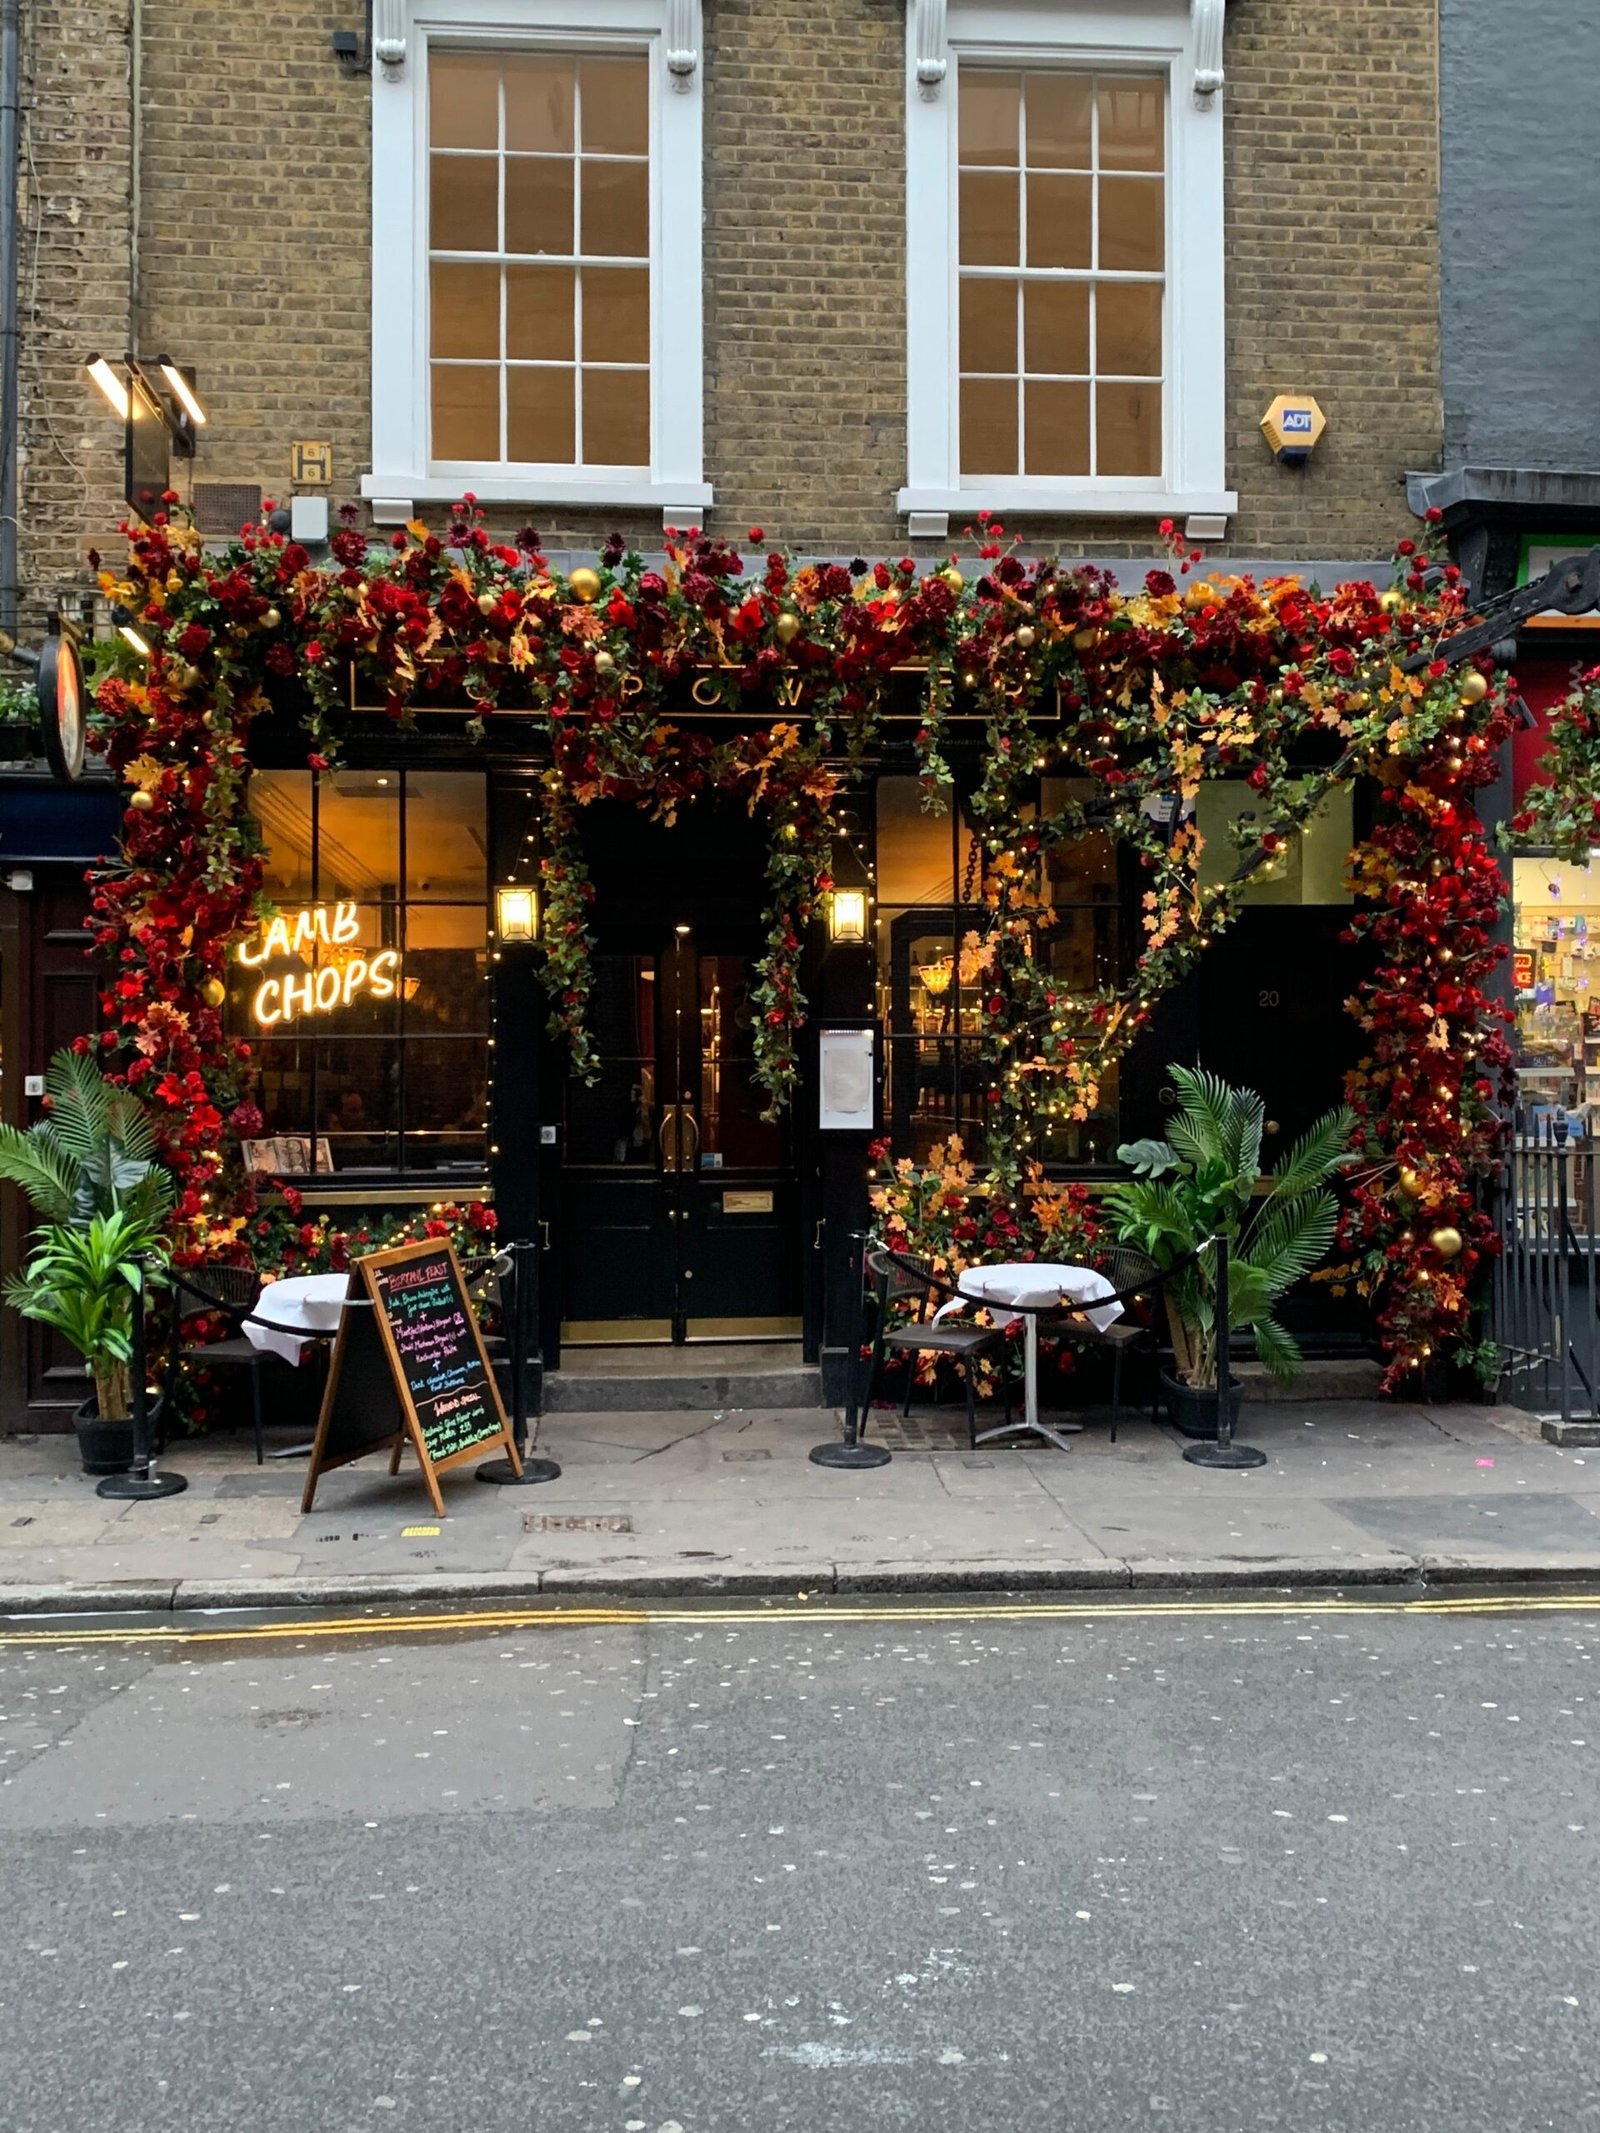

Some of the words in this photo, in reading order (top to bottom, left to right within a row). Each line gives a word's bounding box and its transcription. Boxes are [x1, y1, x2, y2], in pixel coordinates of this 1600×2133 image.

[1283, 413, 1312, 429] ADT
[238, 901, 360, 966] LAMB
[255, 950, 398, 1025] CHOPS
[1259, 990, 1280, 1007] 20
